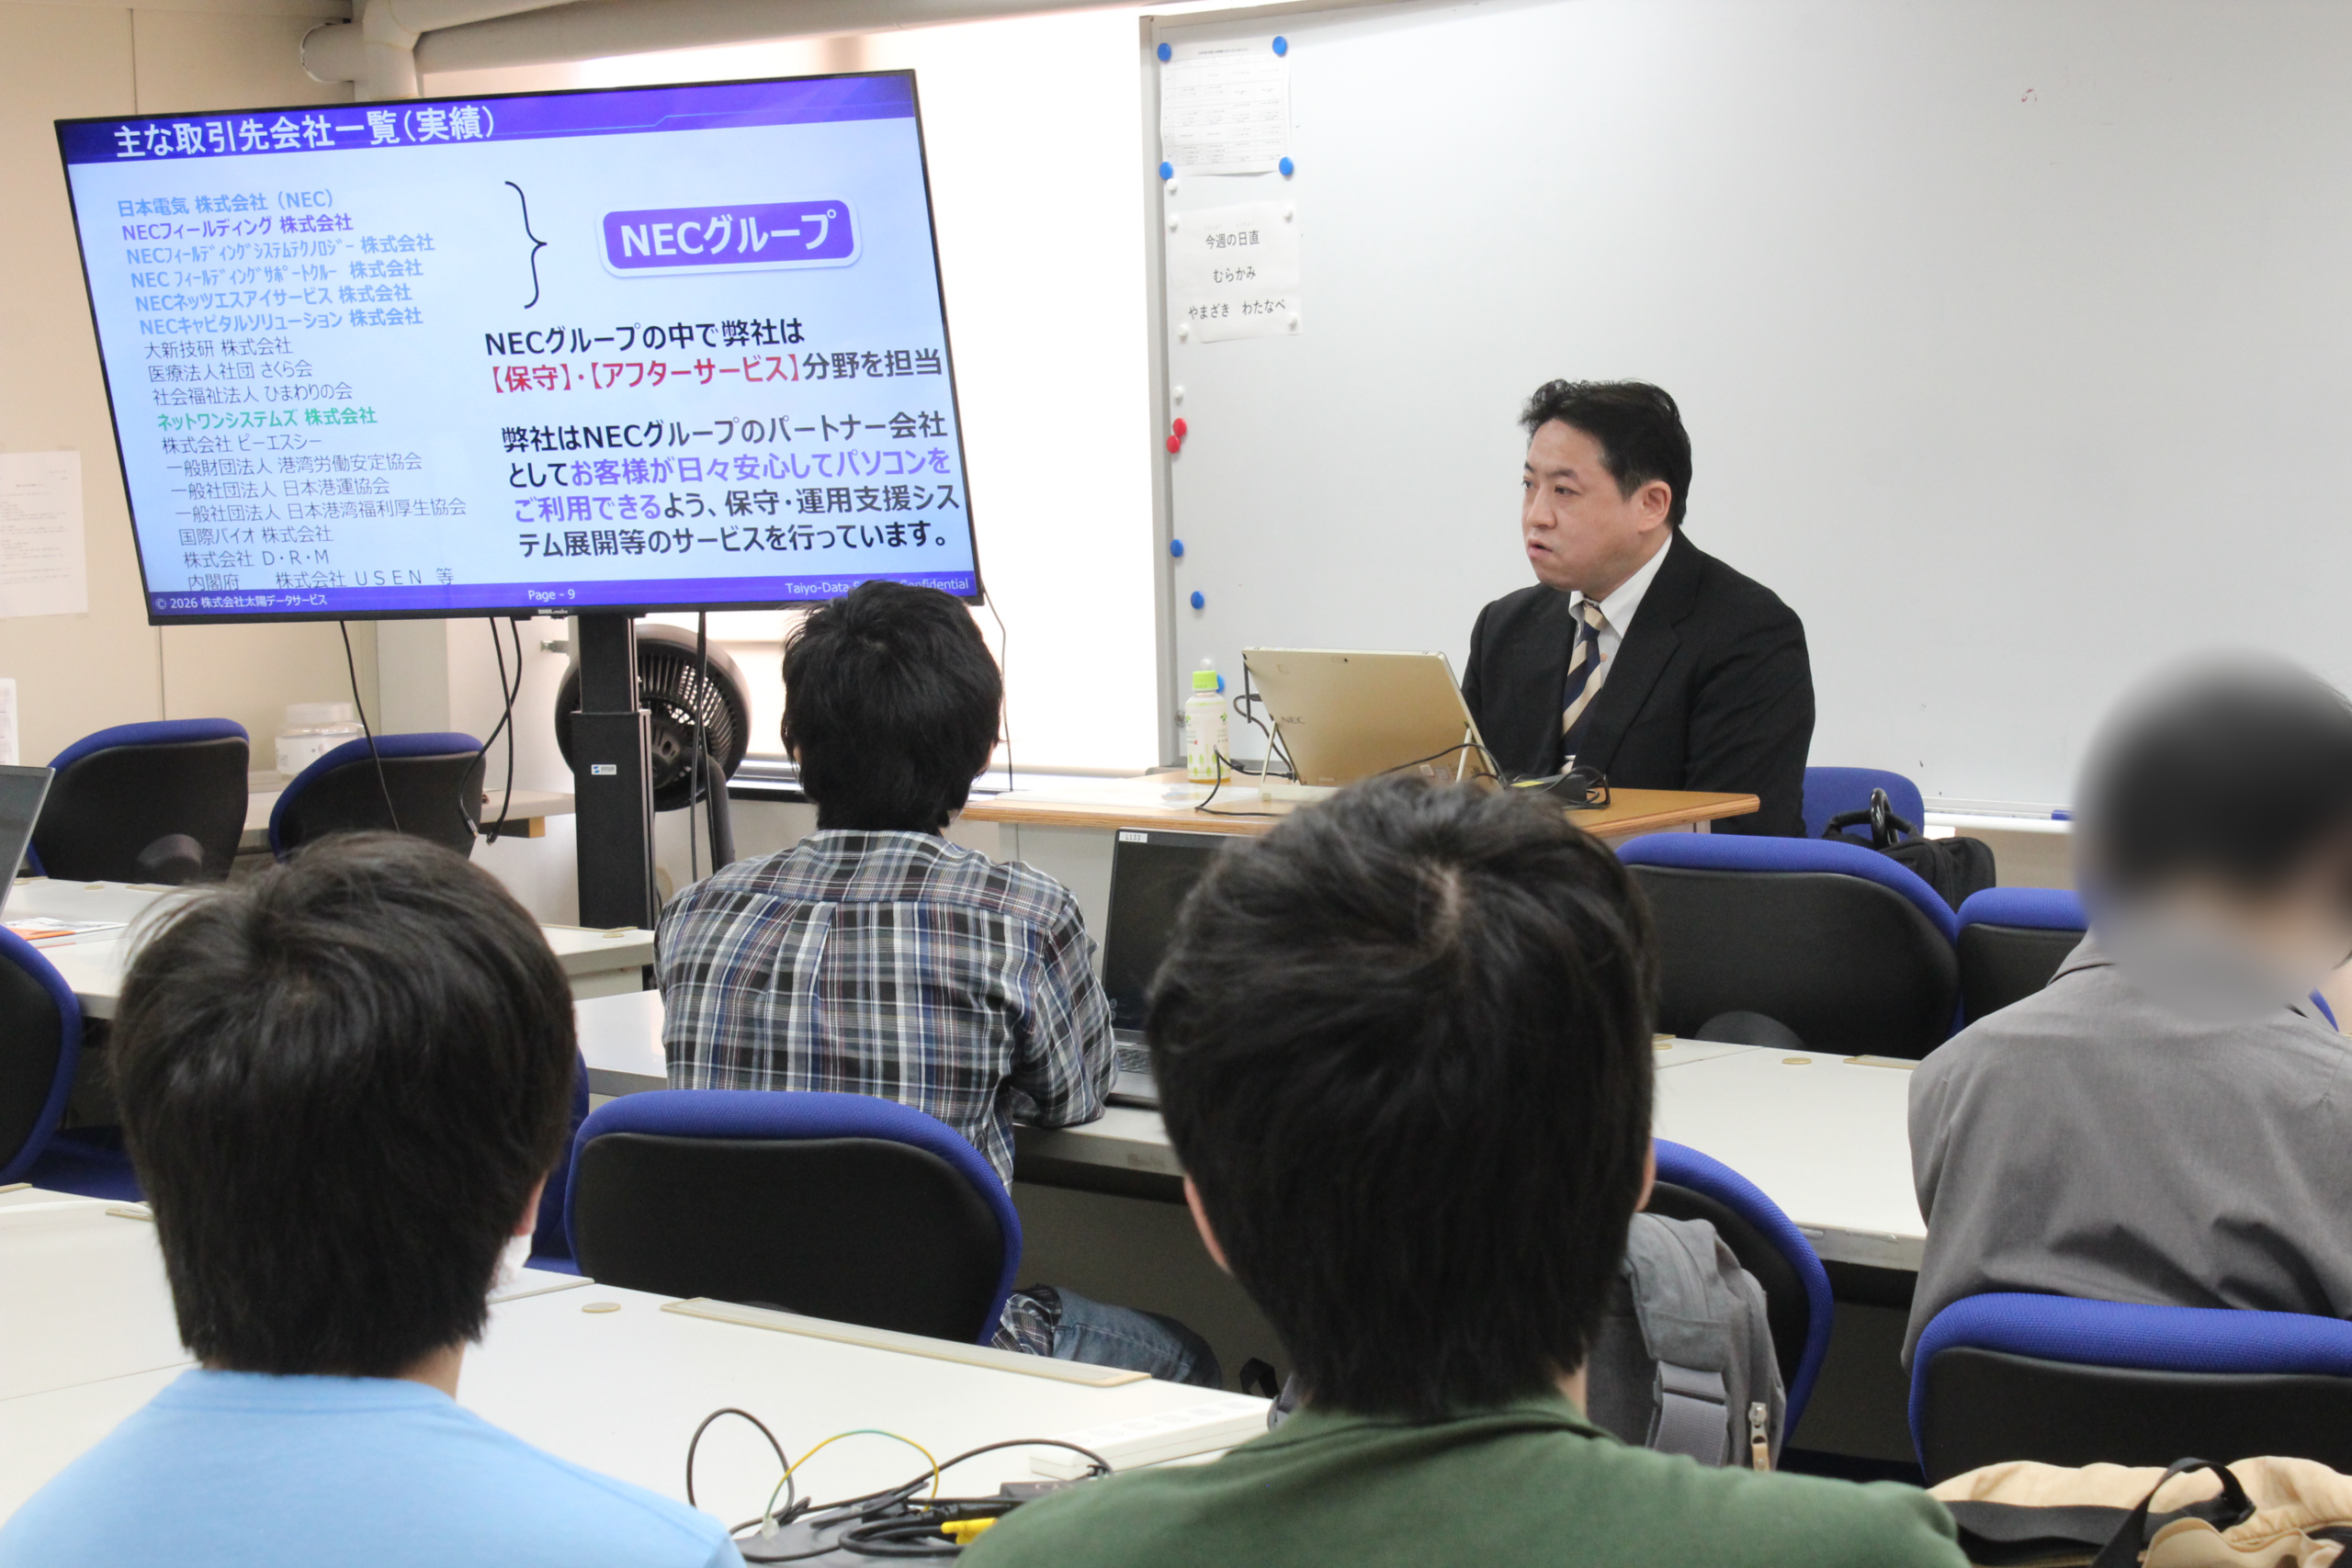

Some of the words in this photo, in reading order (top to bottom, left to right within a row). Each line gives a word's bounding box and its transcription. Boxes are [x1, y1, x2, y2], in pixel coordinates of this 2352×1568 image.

[119, 197, 189, 218] 日本電気
[122, 215, 272, 241] NECフィールディング
[280, 212, 354, 233] 株式会社
[621, 209, 837, 257] NECグループ
[361, 234, 435, 254] 株式会社
[1205, 230, 1260, 250] 今週の日直
[131, 270, 169, 289] NEC
[349, 258, 424, 278] 株式会社
[1213, 265, 1256, 284] むらかみ
[135, 287, 333, 312] NECネッツエスアイサービス
[338, 283, 413, 304] 株式会社
[1189, 302, 1229, 321] やまざき
[1242, 299, 1286, 315] わたなべ
[140, 310, 343, 335] NECキャピタルソリューション
[349, 306, 424, 327] 株式会社
[144, 341, 215, 359] 大新技研
[221, 336, 294, 356] 株式会社
[485, 318, 805, 355] NECグループの中で弊社は
[148, 362, 255, 383] 医療法人社団
[261, 359, 312, 378] さくら会
[153, 386, 259, 407] 社会福祉法人
[265, 381, 354, 402] ひまわりの会
[157, 409, 298, 432] ネットワンシステムズ
[304, 406, 378, 425] 株式会社
[502, 410, 947, 453] 弊社はNECグループのパートナー会社
[162, 435, 233, 455] 株式会社
[239, 434, 322, 451] ピーエスシー
[166, 457, 273, 478] 一般財団法人
[277, 451, 423, 474] 港湾労働安定協会
[508, 447, 951, 488] としてお客様が日々安心してパソコンを
[171, 480, 277, 501] 一般社団法人
[284, 476, 390, 497] 日本港運協会
[175, 503, 281, 524] 一般社団法人
[288, 497, 467, 520] 日本港湾福利厚生協会
[179, 527, 254, 546] 国際バイオ
[261, 524, 334, 544] 株式会社
[519, 518, 946, 558] テム展開等のサービスを行っています。
[183, 549, 253, 570] 株式会社
[187, 573, 240, 592] 内閣府
[275, 570, 347, 590] 株式会社
[436, 567, 455, 585] 等
[786, 581, 848, 596] Taiyo-Data
[170, 596, 198, 609] 2026
[200, 592, 328, 609] 株式会社太陽データサービス
[528, 588, 556, 602] Page
[568, 587, 576, 599] 9
[1281, 716, 1306, 725] NEC
